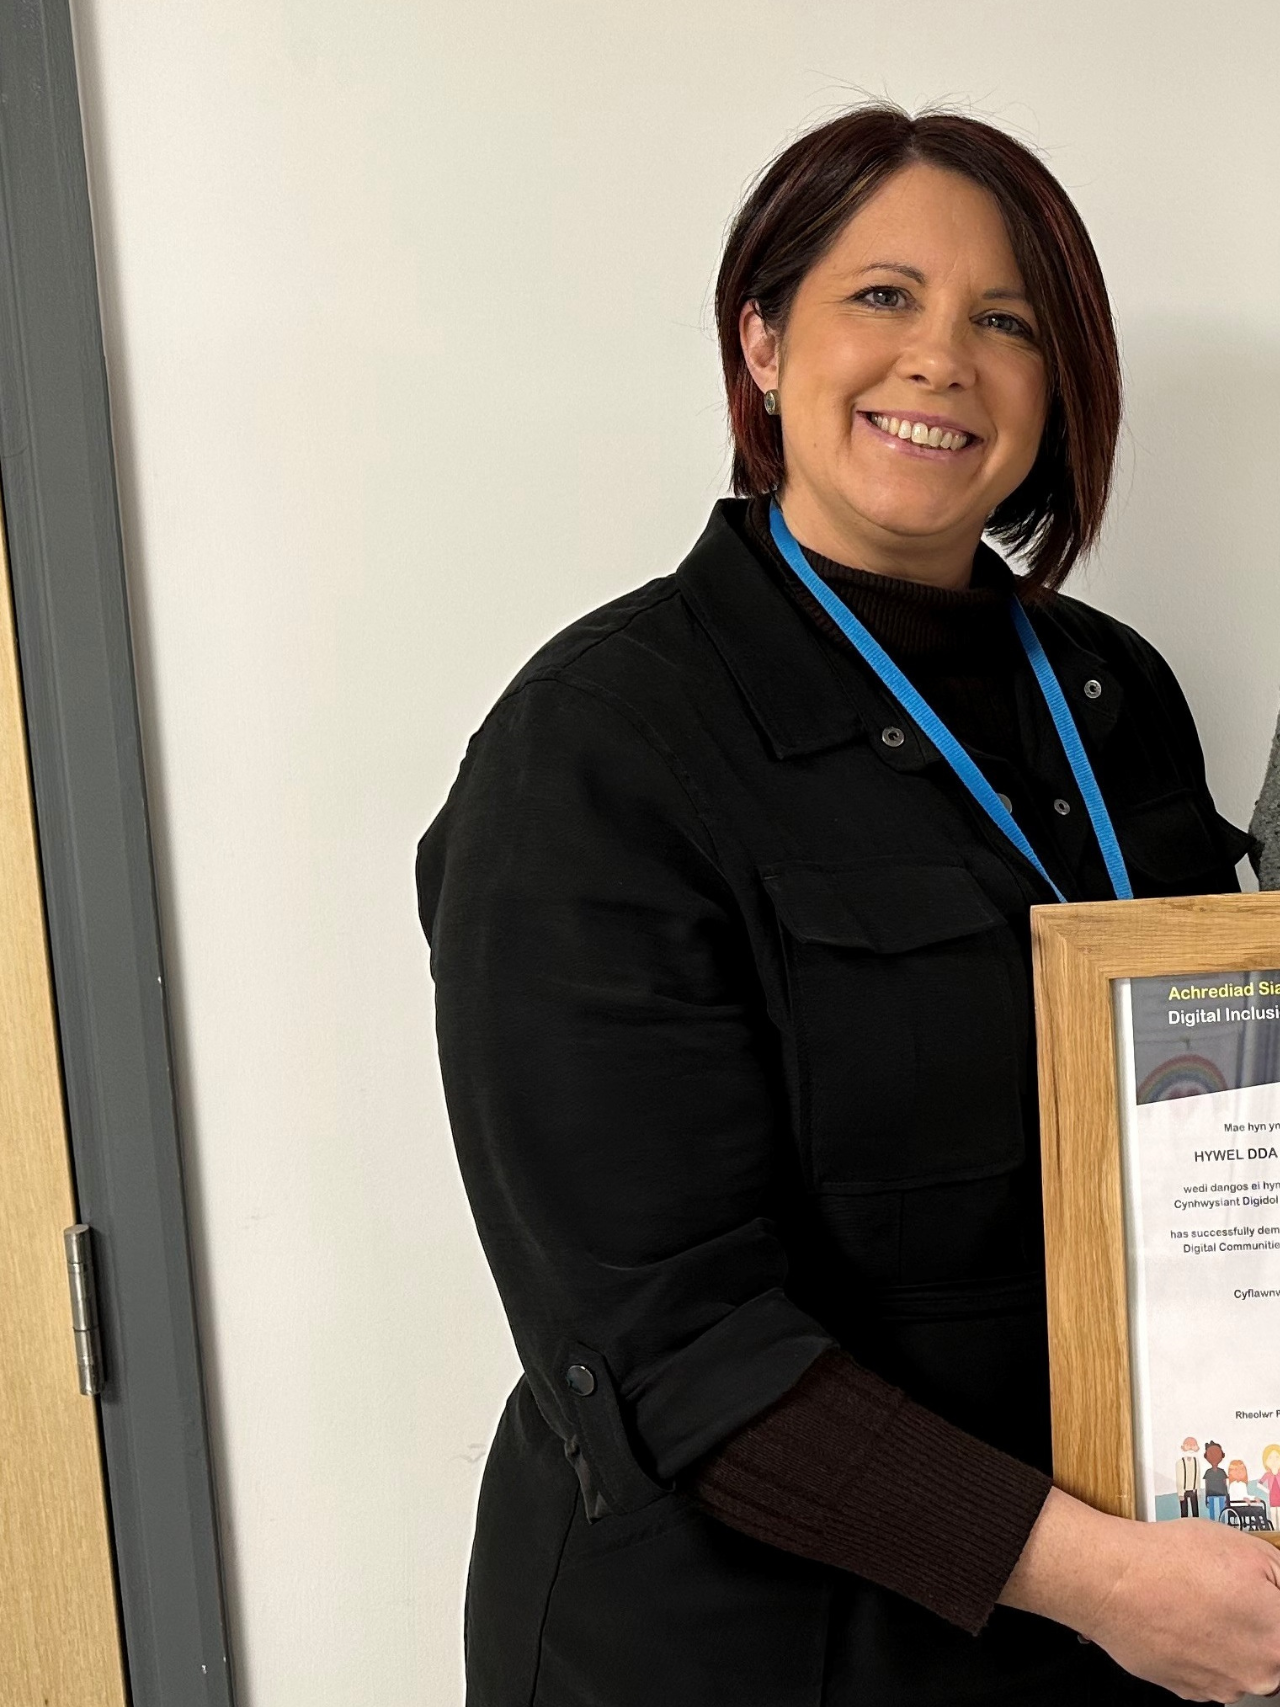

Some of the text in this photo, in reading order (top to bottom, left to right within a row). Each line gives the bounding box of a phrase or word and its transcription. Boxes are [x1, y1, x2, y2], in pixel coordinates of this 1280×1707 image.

[1168, 983, 1254, 1001] Achrediad
[1168, 1008, 1221, 1027] Digital
[1224, 1123, 1245, 1132] Mae
[1248, 1121, 1267, 1132] hyn
[1269, 1122, 1280, 1132] yn
[1194, 1150, 1244, 1162] HYWEL
[1248, 1147, 1278, 1160] DDA
[1184, 1184, 1208, 1194] wedi
[1210, 1182, 1249, 1194] dangos
[1251, 1181, 1260, 1191] ei
[1174, 1197, 1240, 1211] Cynhwysiant
[1243, 1195, 1279, 1208] Digidol
[1171, 1229, 1188, 1238] has
[1191, 1225, 1255, 1239] successfully
[1183, 1242, 1217, 1255] Digital
[1235, 1410, 1274, 1419] Rheolwr
